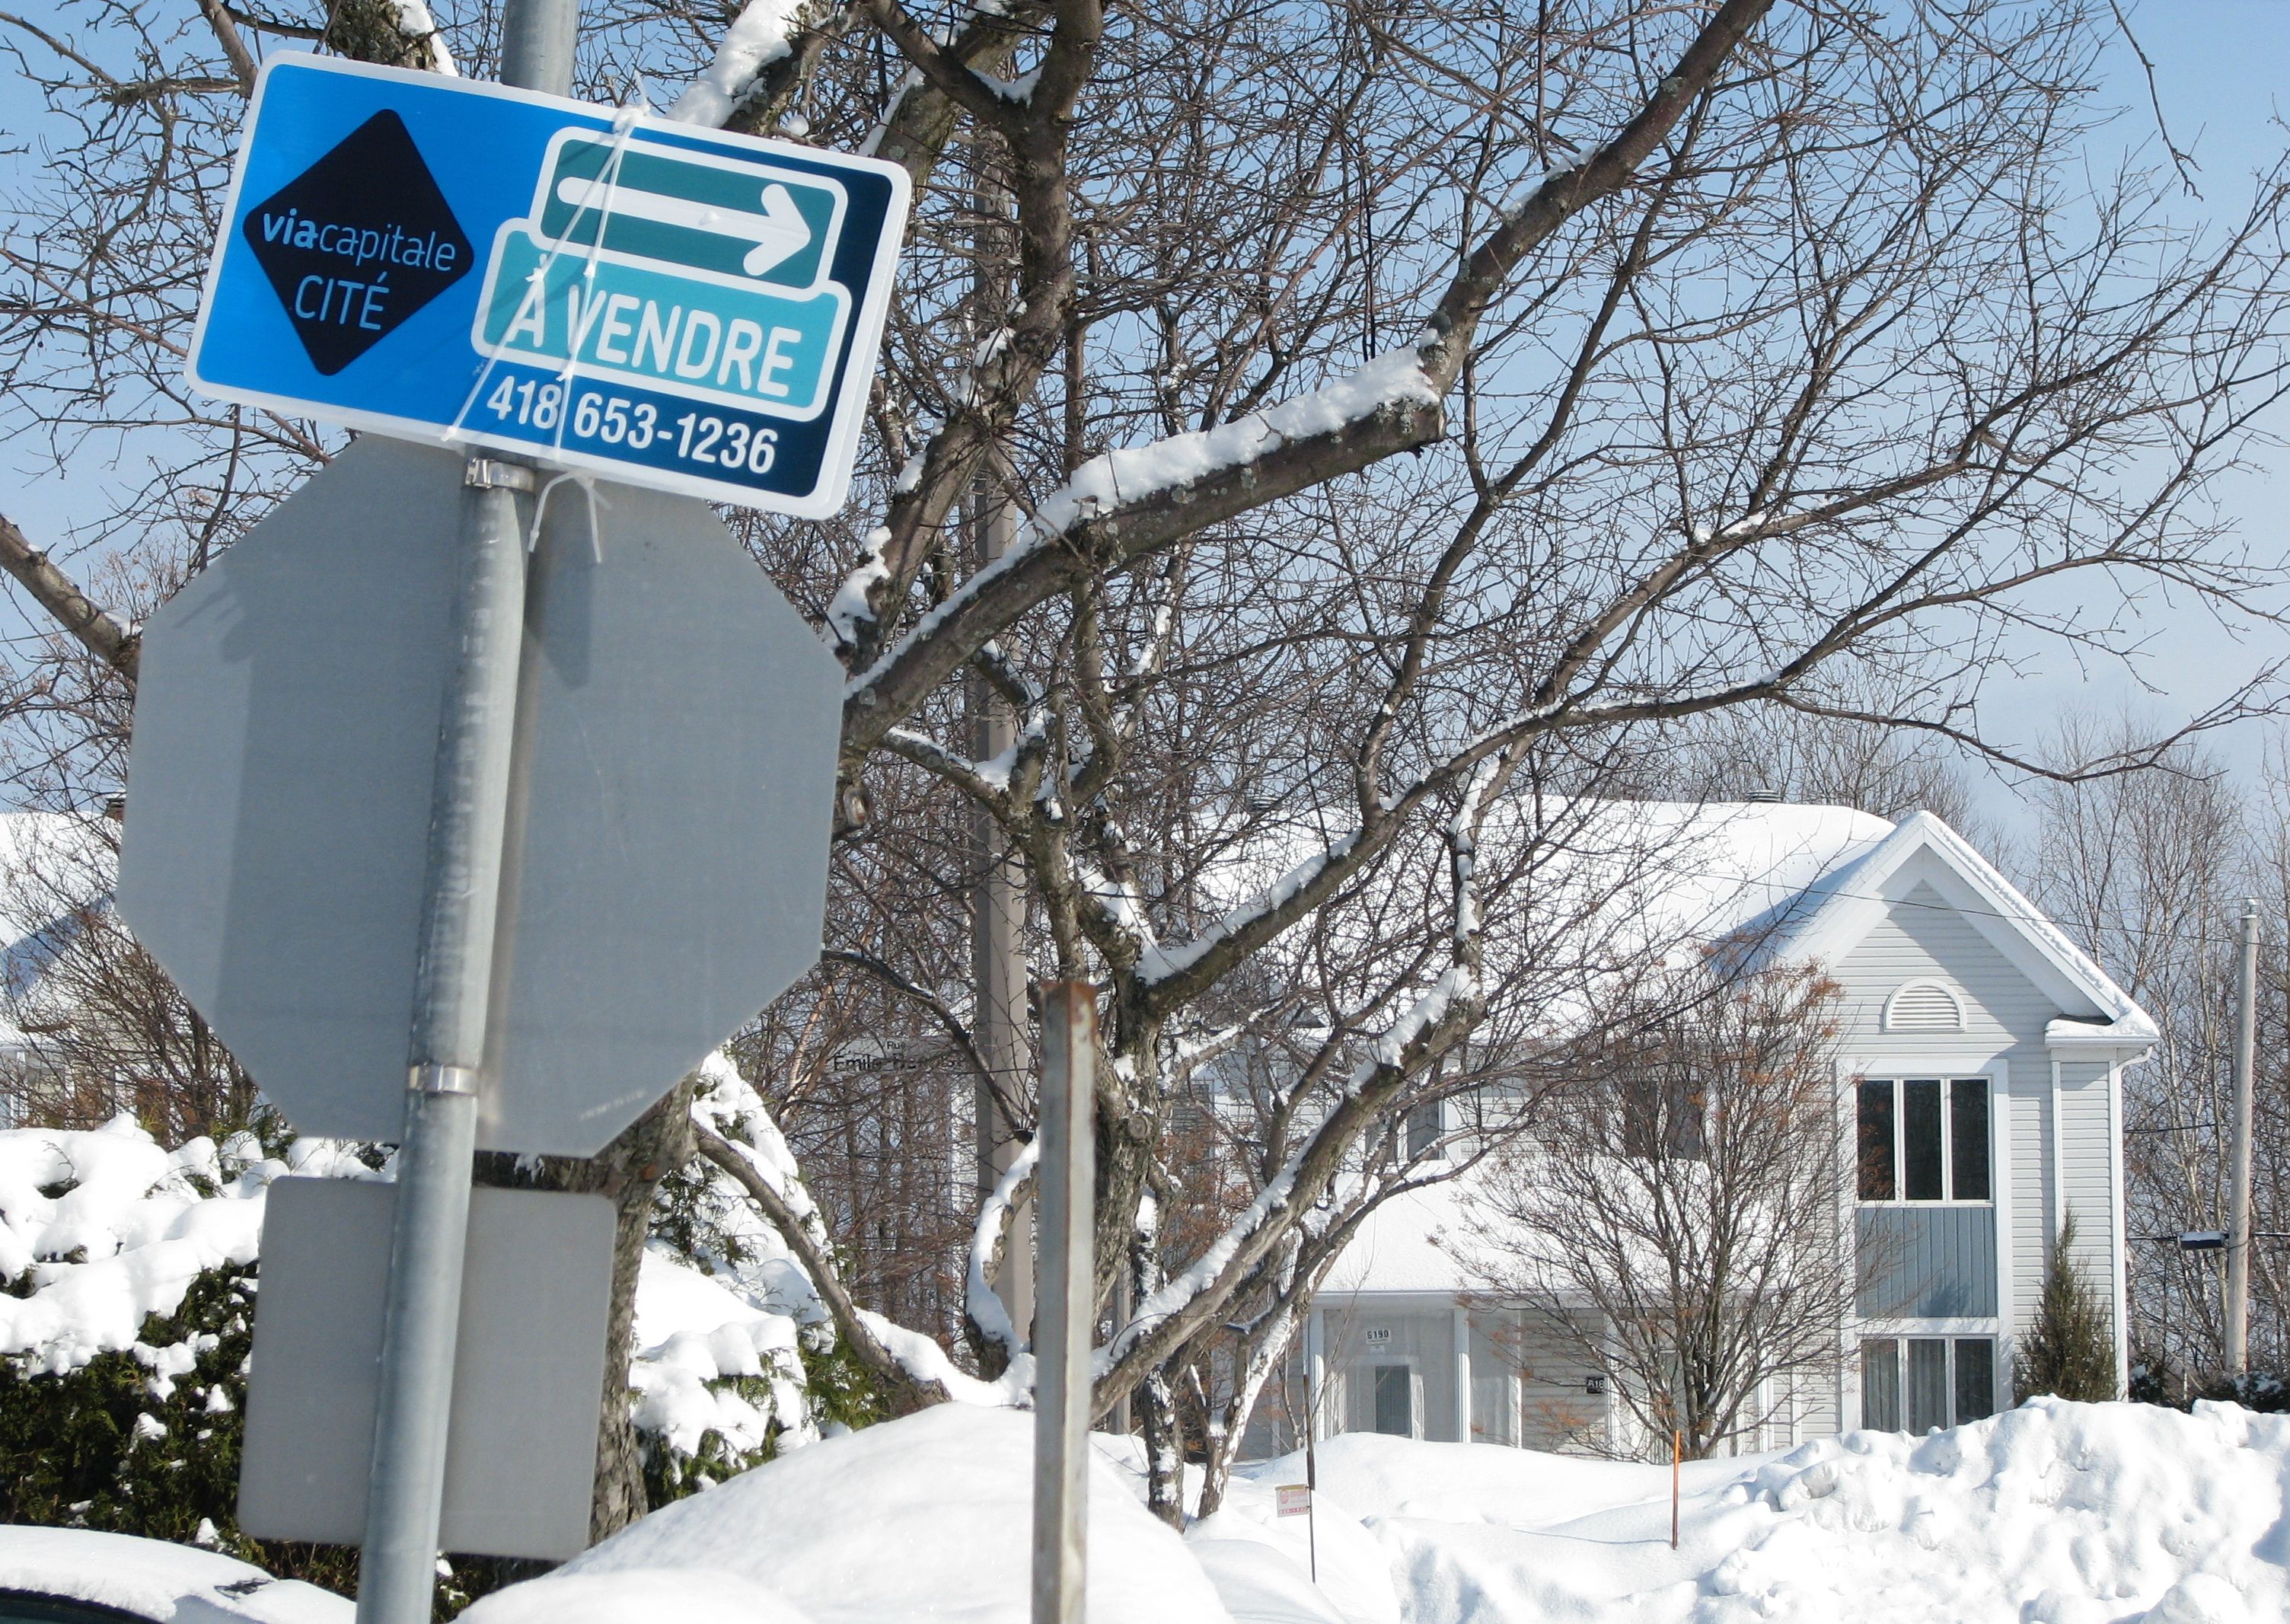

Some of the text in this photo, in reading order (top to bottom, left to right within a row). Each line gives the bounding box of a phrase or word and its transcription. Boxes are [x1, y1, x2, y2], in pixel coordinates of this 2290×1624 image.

[263, 208, 455, 272] viacapitale
[295, 271, 389, 330] CITÉ
[568, 284, 802, 397] VENDRE
[487, 375, 778, 474] 418 653-1236
[887, 1041, 905, 1050] Rue
[1367, 1330, 1389, 1340] 6190
[1589, 1380, 1604, 1389] 618
